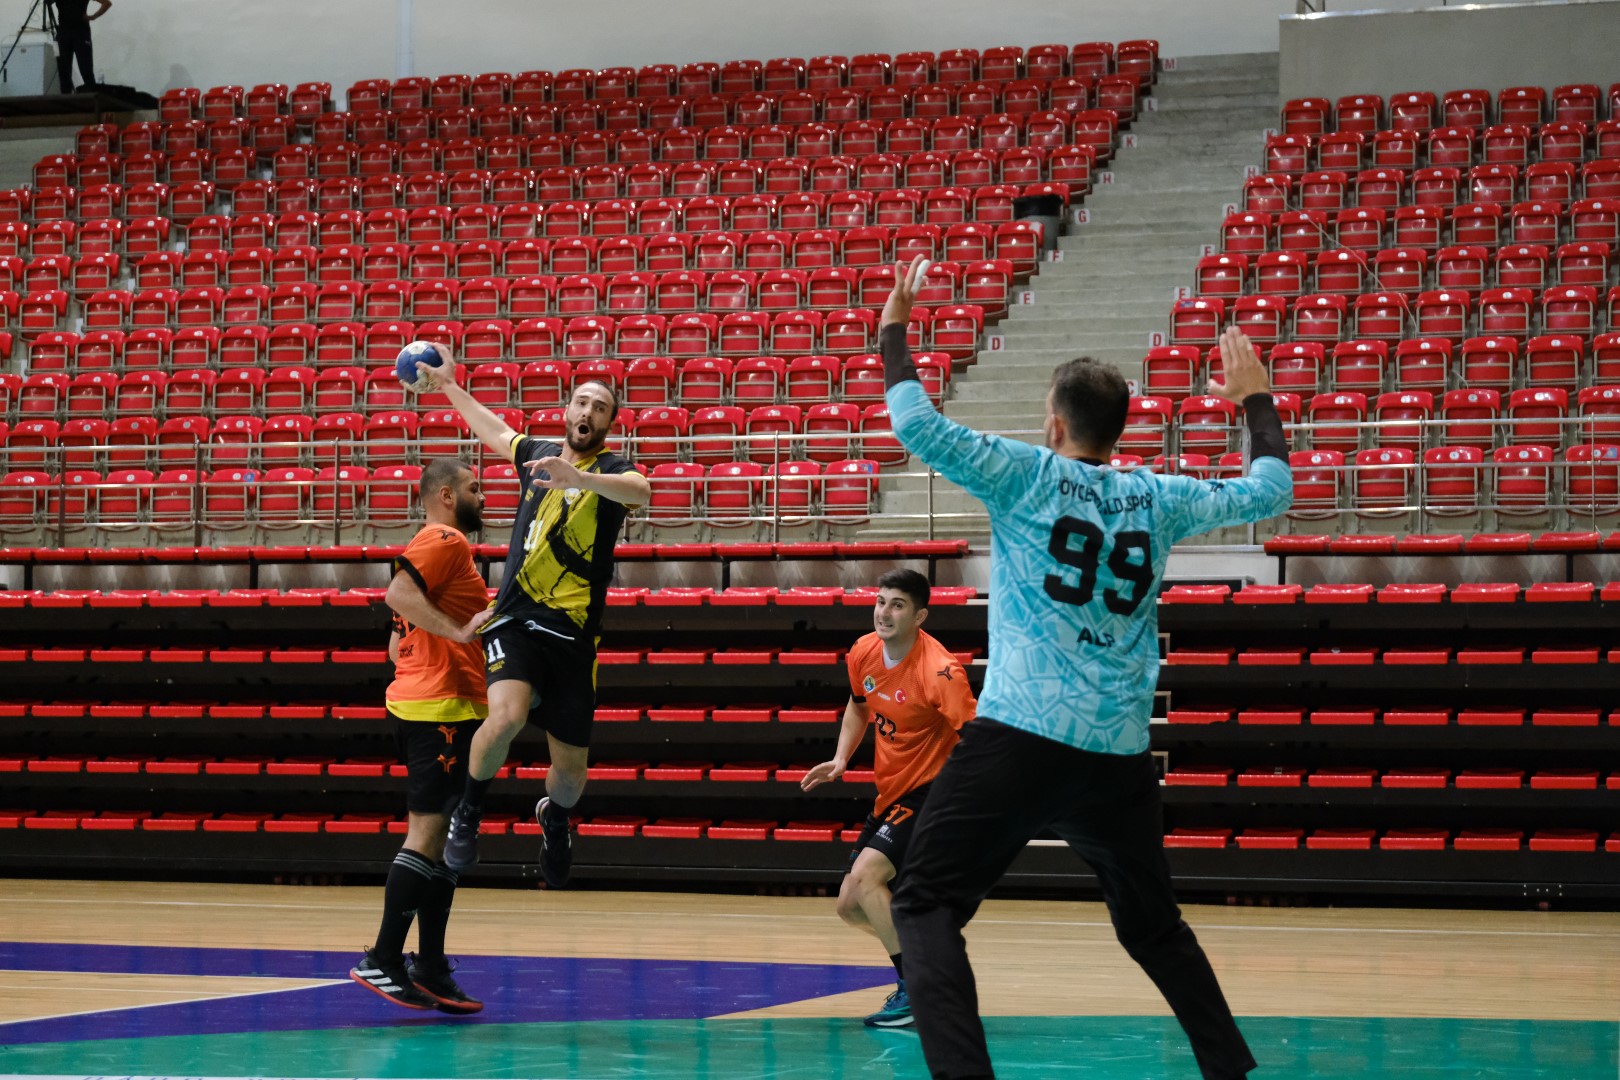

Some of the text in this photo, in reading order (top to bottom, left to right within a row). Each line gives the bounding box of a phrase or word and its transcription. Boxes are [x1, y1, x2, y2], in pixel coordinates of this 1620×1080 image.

[523, 519, 544, 551] 11
[1043, 515, 1155, 616] 99
[487, 637, 506, 664] 11
[1077, 626, 1116, 648] ALP
